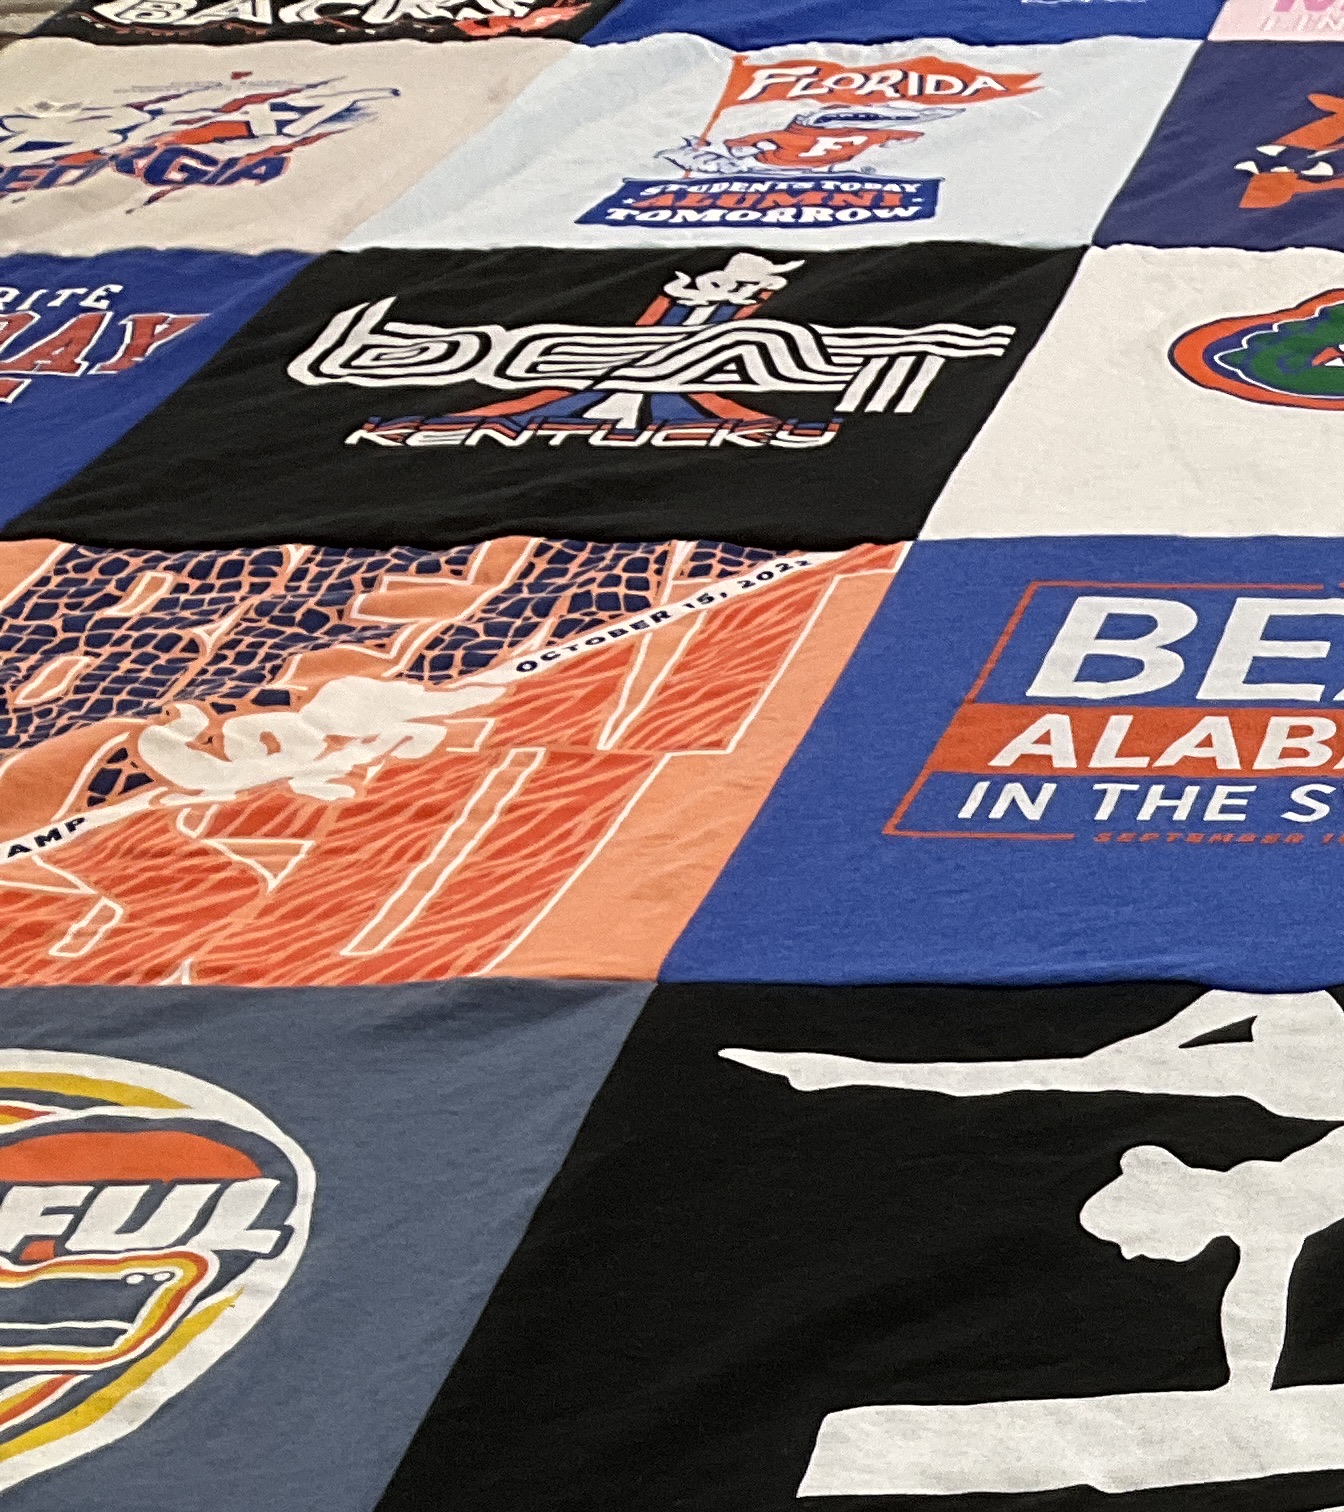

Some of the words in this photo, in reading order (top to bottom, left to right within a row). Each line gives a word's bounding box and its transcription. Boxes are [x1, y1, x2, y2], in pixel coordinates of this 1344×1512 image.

[737, 66, 1013, 101] FLORIDA
[631, 190, 904, 209] ALUMNI
[639, 180, 814, 196] STUDENTS
[821, 180, 922, 194] TODAY
[605, 206, 922, 224] TOMORROW
[344, 417, 845, 449] KENTUCKY
[514, 603, 676, 674] OCTOBER
[681, 585, 729, 617] 15,
[956, 780, 1058, 822] IN
[1092, 781, 1250, 823] THE
